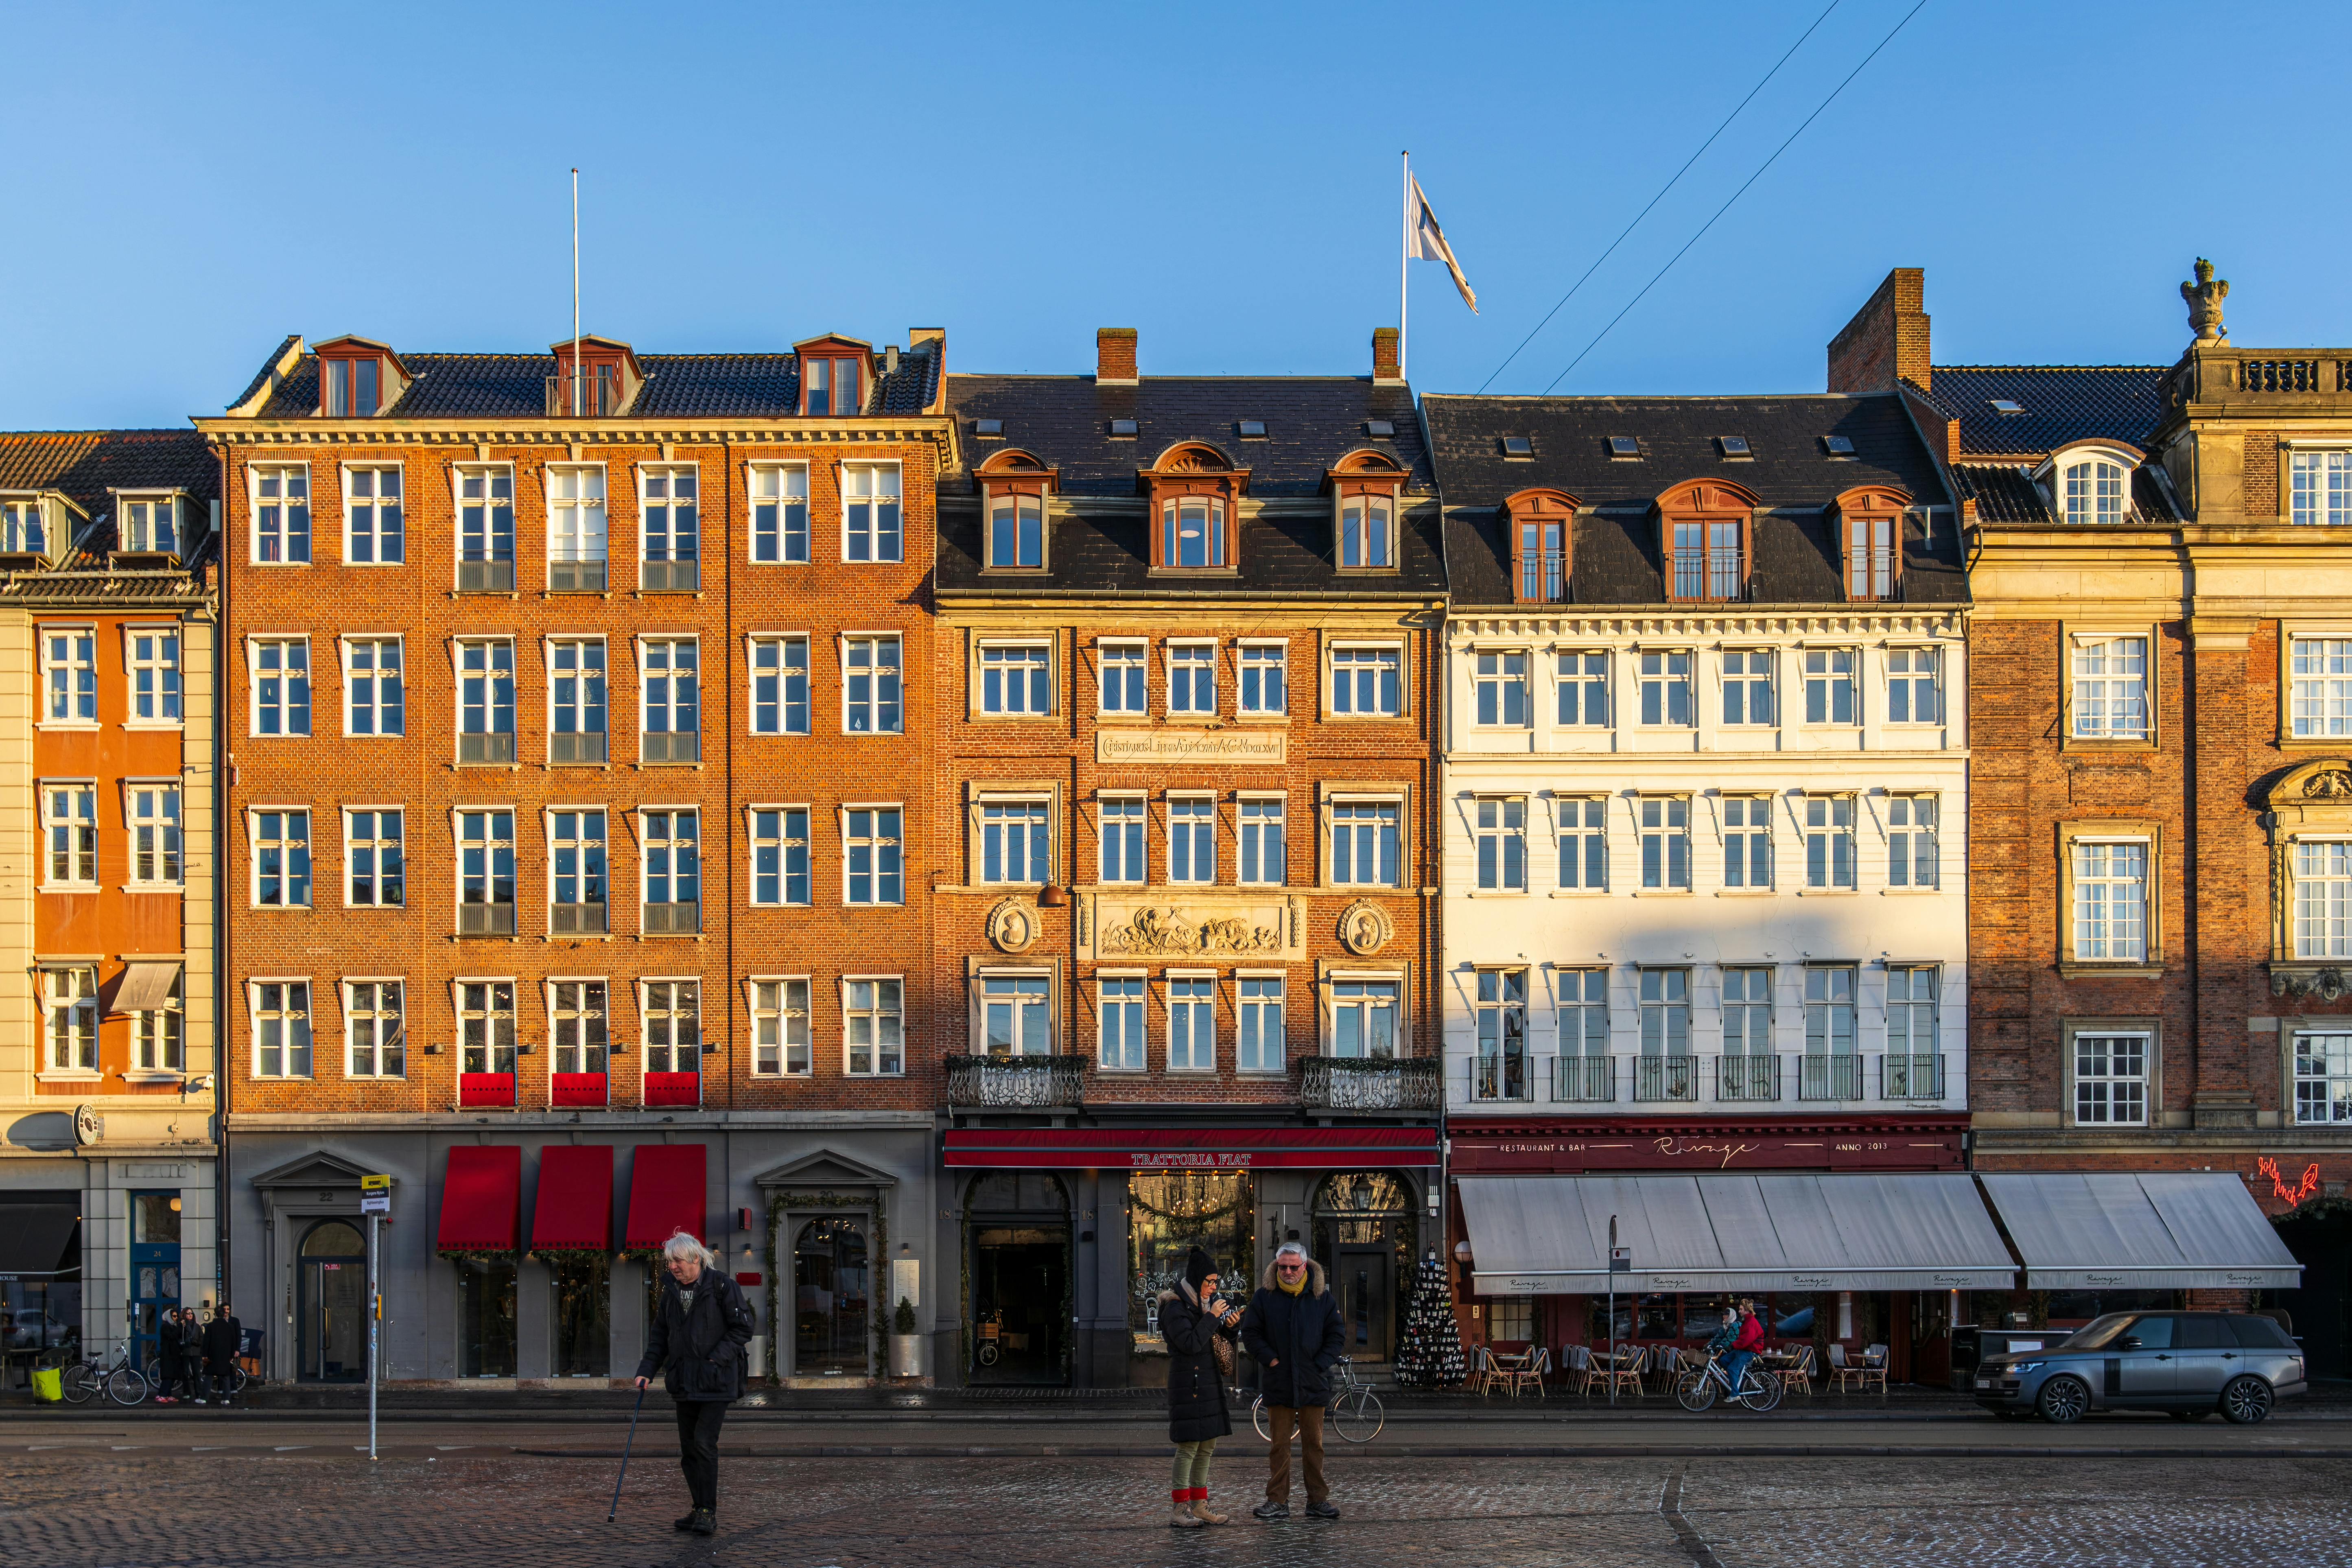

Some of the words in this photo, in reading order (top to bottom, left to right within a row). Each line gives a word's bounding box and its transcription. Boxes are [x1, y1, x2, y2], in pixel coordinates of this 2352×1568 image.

[81, 1105, 96, 1122] ESPRESSO
[1131, 1154, 1215, 1165] TRATTORIA
[1218, 1154, 1251, 1165] FIAT
[2258, 1157, 2276, 1179] gold
[2274, 1172, 2297, 1207] finch
[319, 1192, 333, 1201] 22
[937, 1209, 951, 1220] 18
[1082, 1209, 1094, 1220] 18
